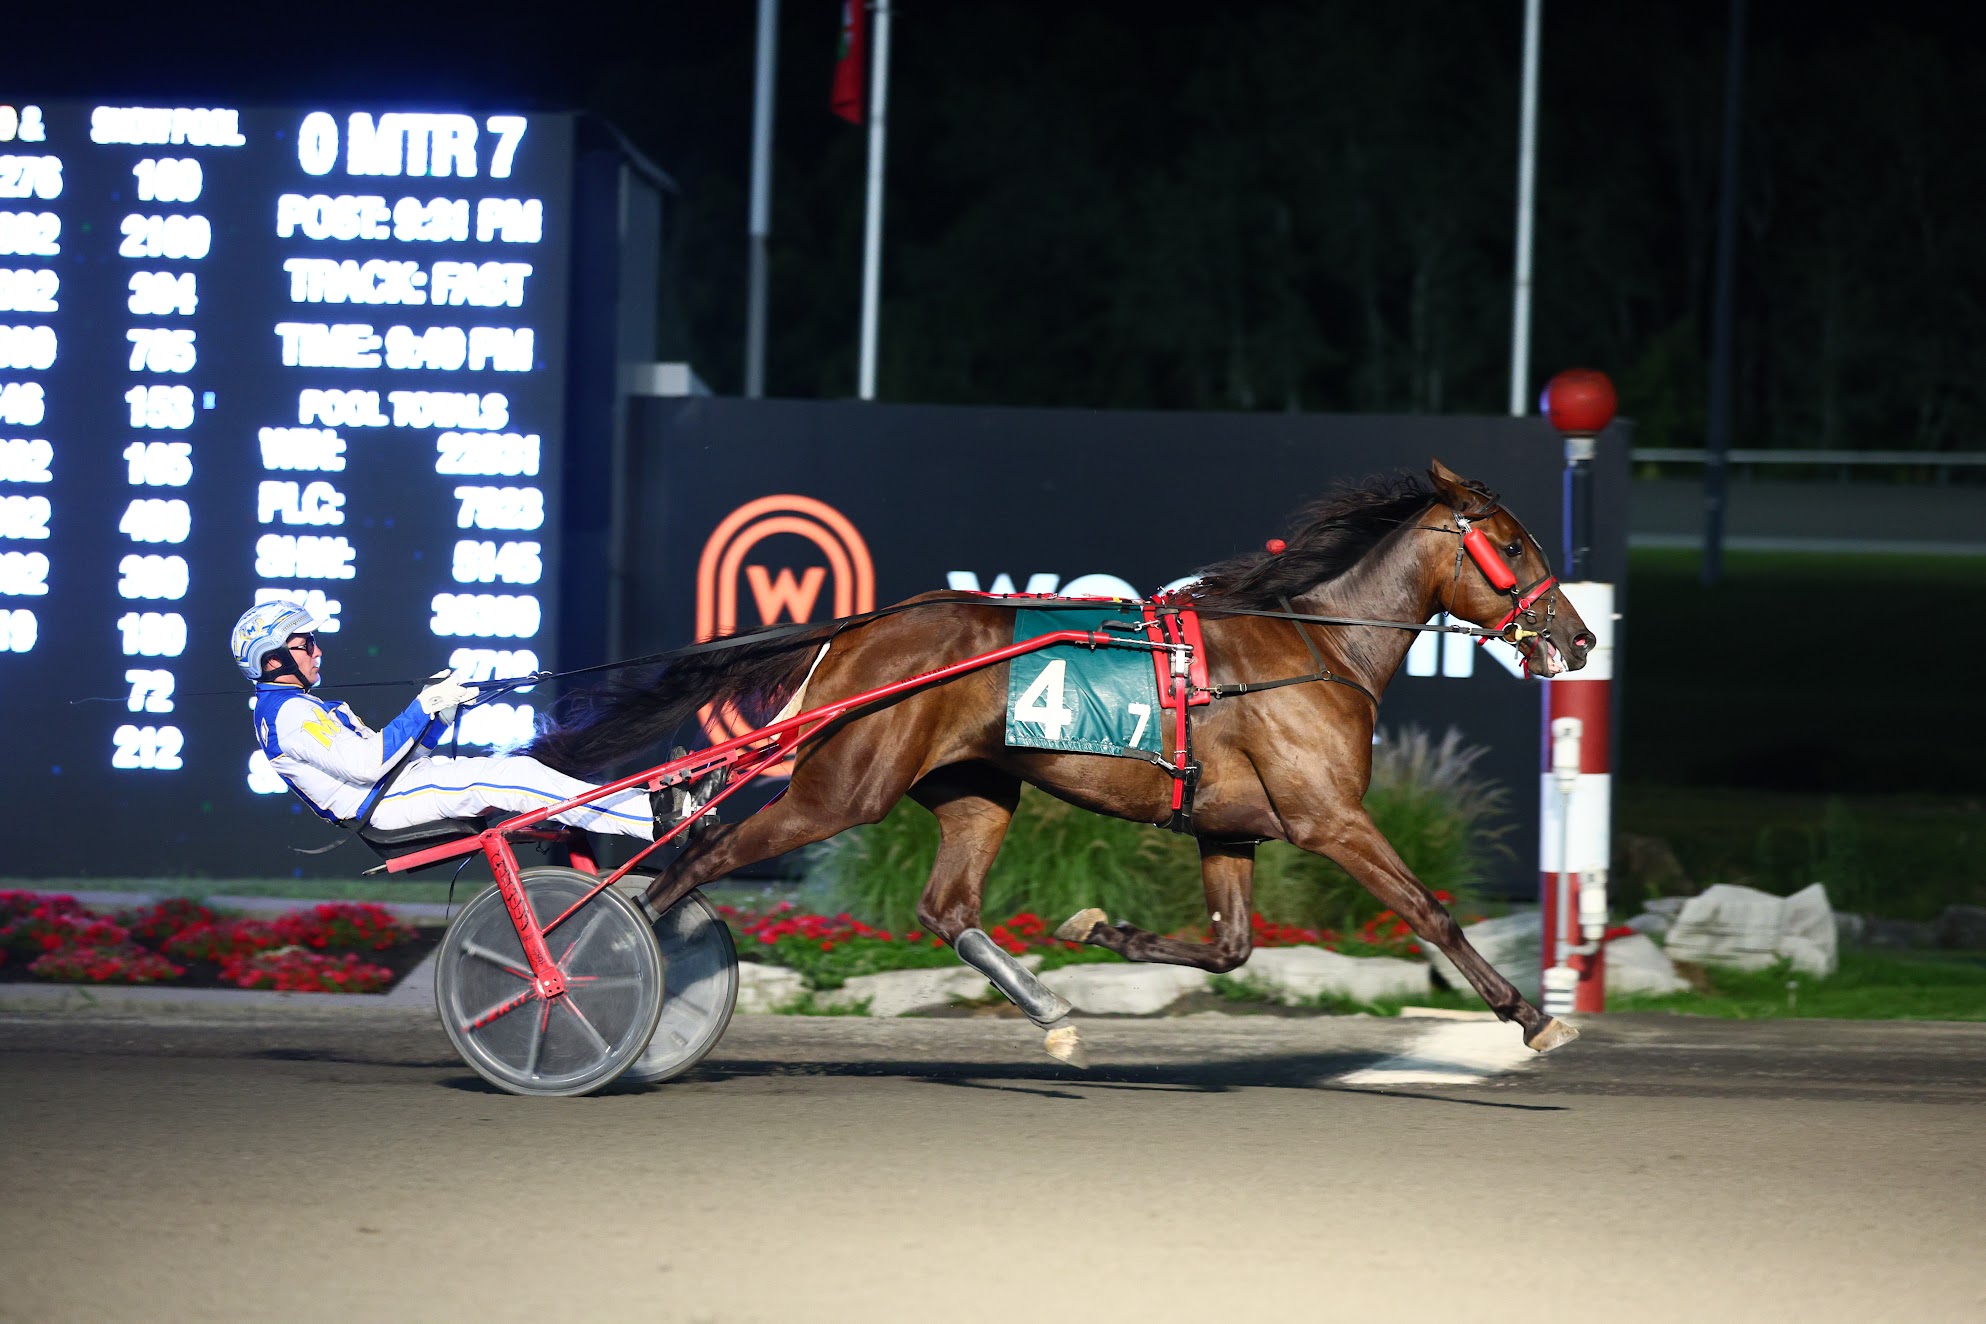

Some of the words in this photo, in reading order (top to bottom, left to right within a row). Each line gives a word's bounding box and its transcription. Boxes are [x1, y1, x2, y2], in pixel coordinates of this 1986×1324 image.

[347, 112, 478, 178] MTR
[487, 116, 528, 178] 7
[277, 194, 391, 241] POST:
[477, 198, 543, 243] PM
[283, 258, 427, 305] TRACK:
[431, 261, 533, 307] FAST
[274, 322, 383, 369] TIME:
[468, 327, 535, 371] PM
[299, 389, 389, 427] POOL
[388, 391, 509, 430] TOTALS
[259, 427, 346, 471] WIN:
[258, 481, 346, 526] PLC:
[745, 565, 827, 625] W
[125, 669, 174, 712] 72
[1014, 659, 1072, 740] 4
[112, 725, 184, 769] 212
[301, 707, 341, 751] M
[1128, 702, 1151, 748] 7
